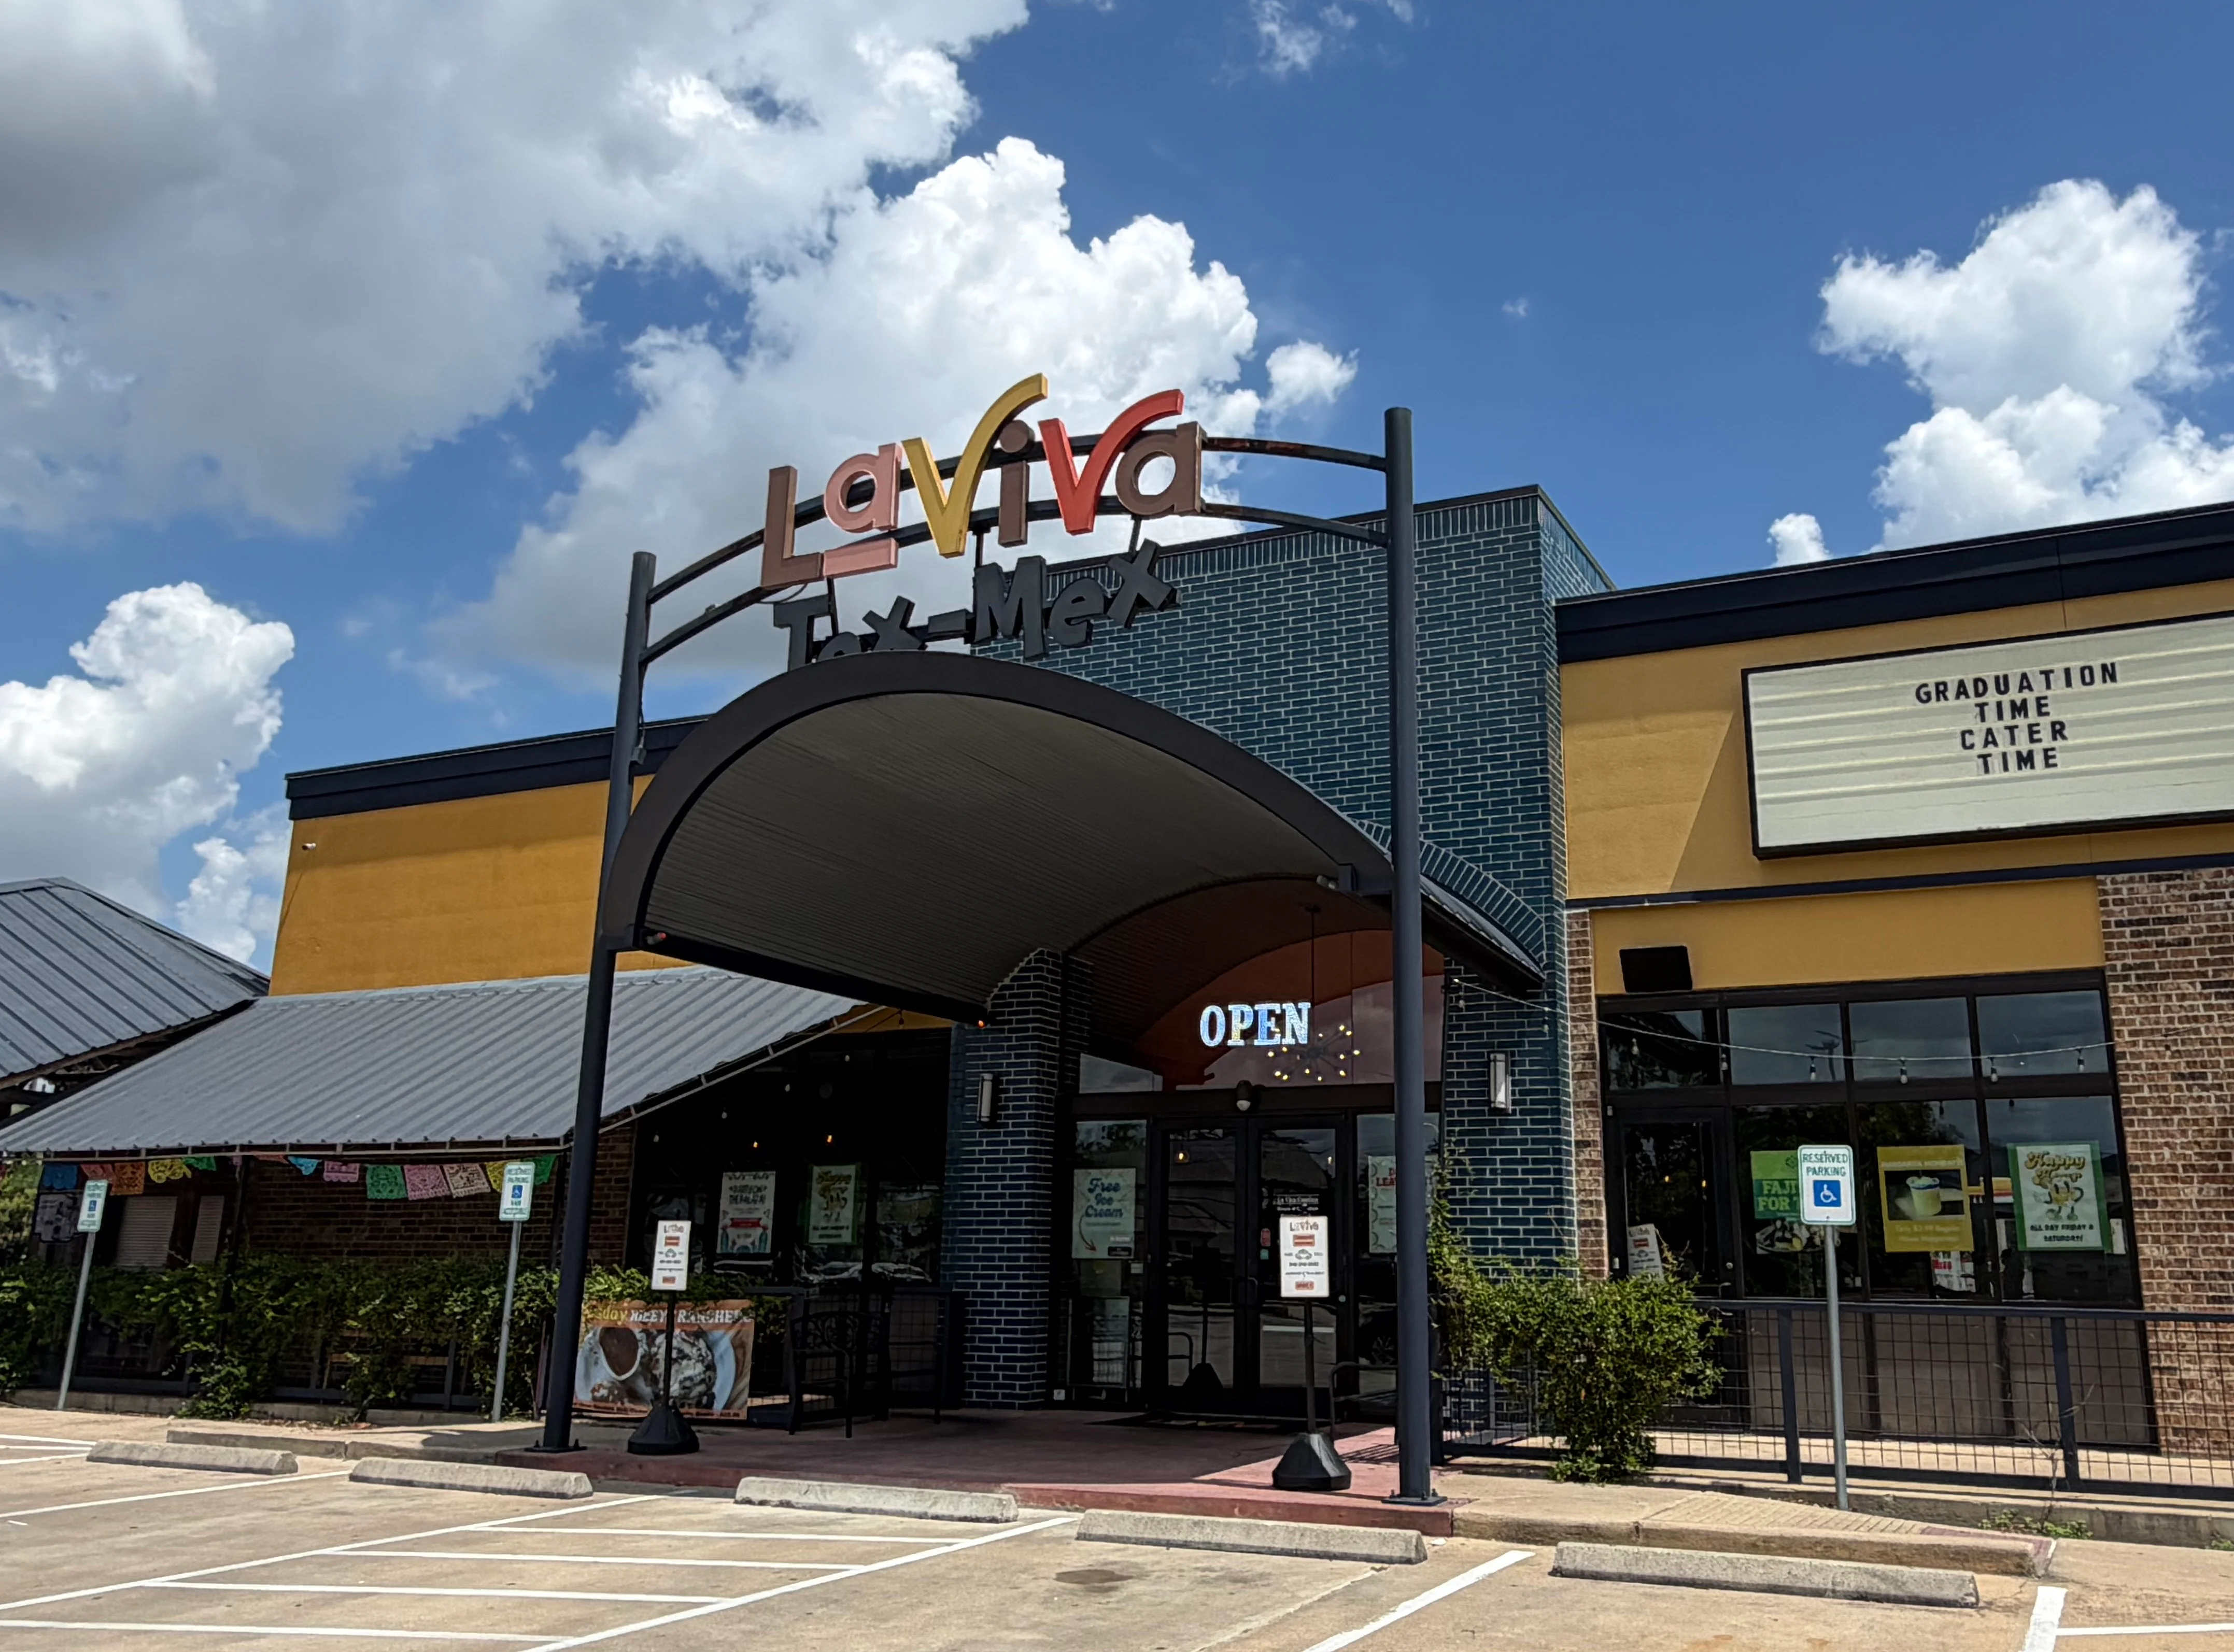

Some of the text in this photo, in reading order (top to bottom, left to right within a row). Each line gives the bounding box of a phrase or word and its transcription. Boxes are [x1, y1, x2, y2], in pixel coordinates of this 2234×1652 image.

[1915, 662, 2117, 704] GRADUATION
[1974, 695, 2051, 722] TIME
[1960, 720, 2068, 750] CATER
[1977, 747, 2058, 774] TIME
[1199, 1002, 1311, 1047] OPEN
[1803, 1153, 1848, 1163] RESERVED
[1806, 1166, 1846, 1176] PARKING
[1087, 1177, 1121, 1193] Free
[1763, 1180, 1797, 1195] FAJI
[1094, 1193, 1114, 1206] Ice
[1758, 1196, 1791, 1212] FOR
[1084, 1205, 1124, 1218] Cream
